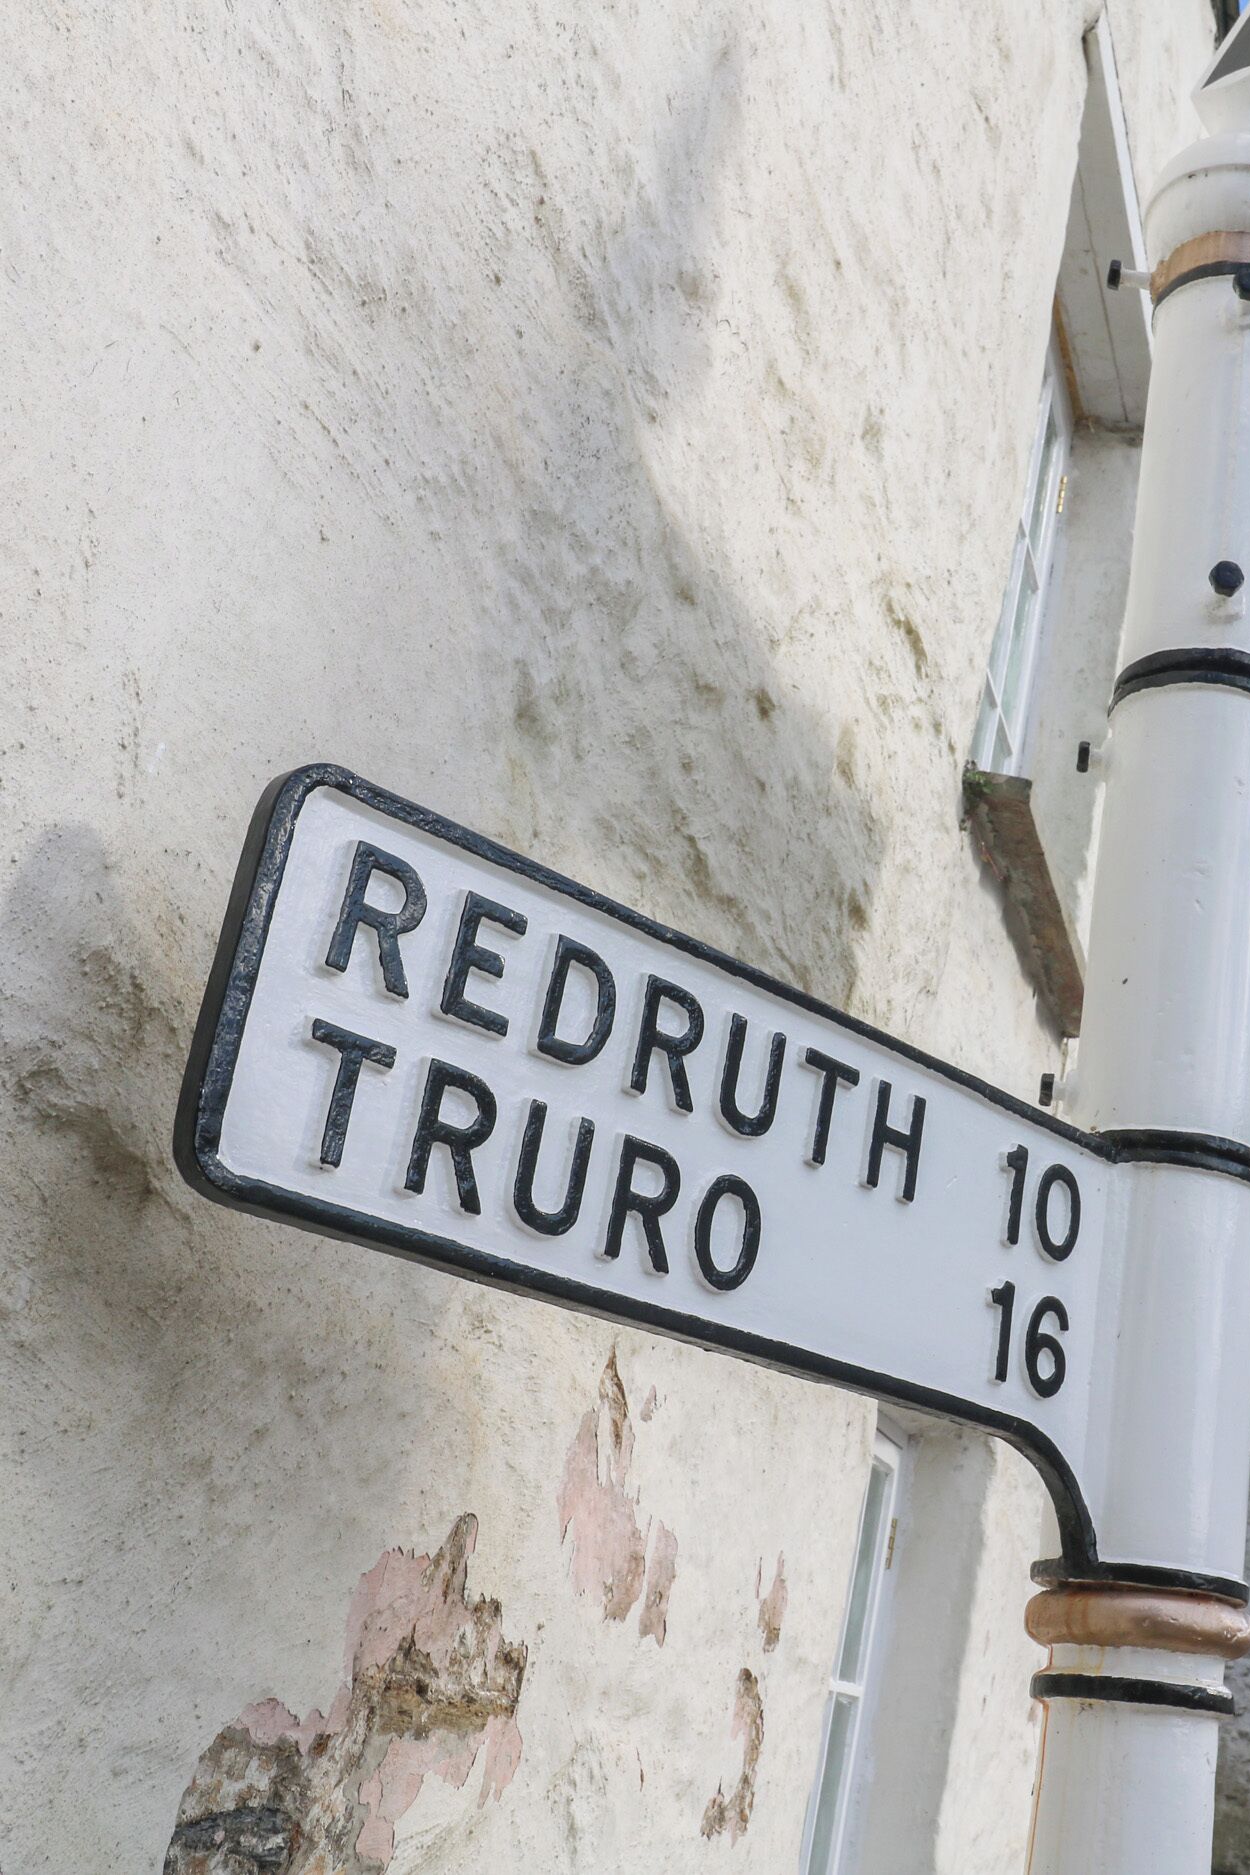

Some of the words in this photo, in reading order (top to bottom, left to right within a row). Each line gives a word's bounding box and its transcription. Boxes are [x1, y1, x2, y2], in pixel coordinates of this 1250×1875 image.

[311, 1018, 762, 1292] TRURO
[990, 1280, 1070, 1399] 16
[324, 840, 927, 1203] REDRUTH
[1006, 1144, 1081, 1262] 10
